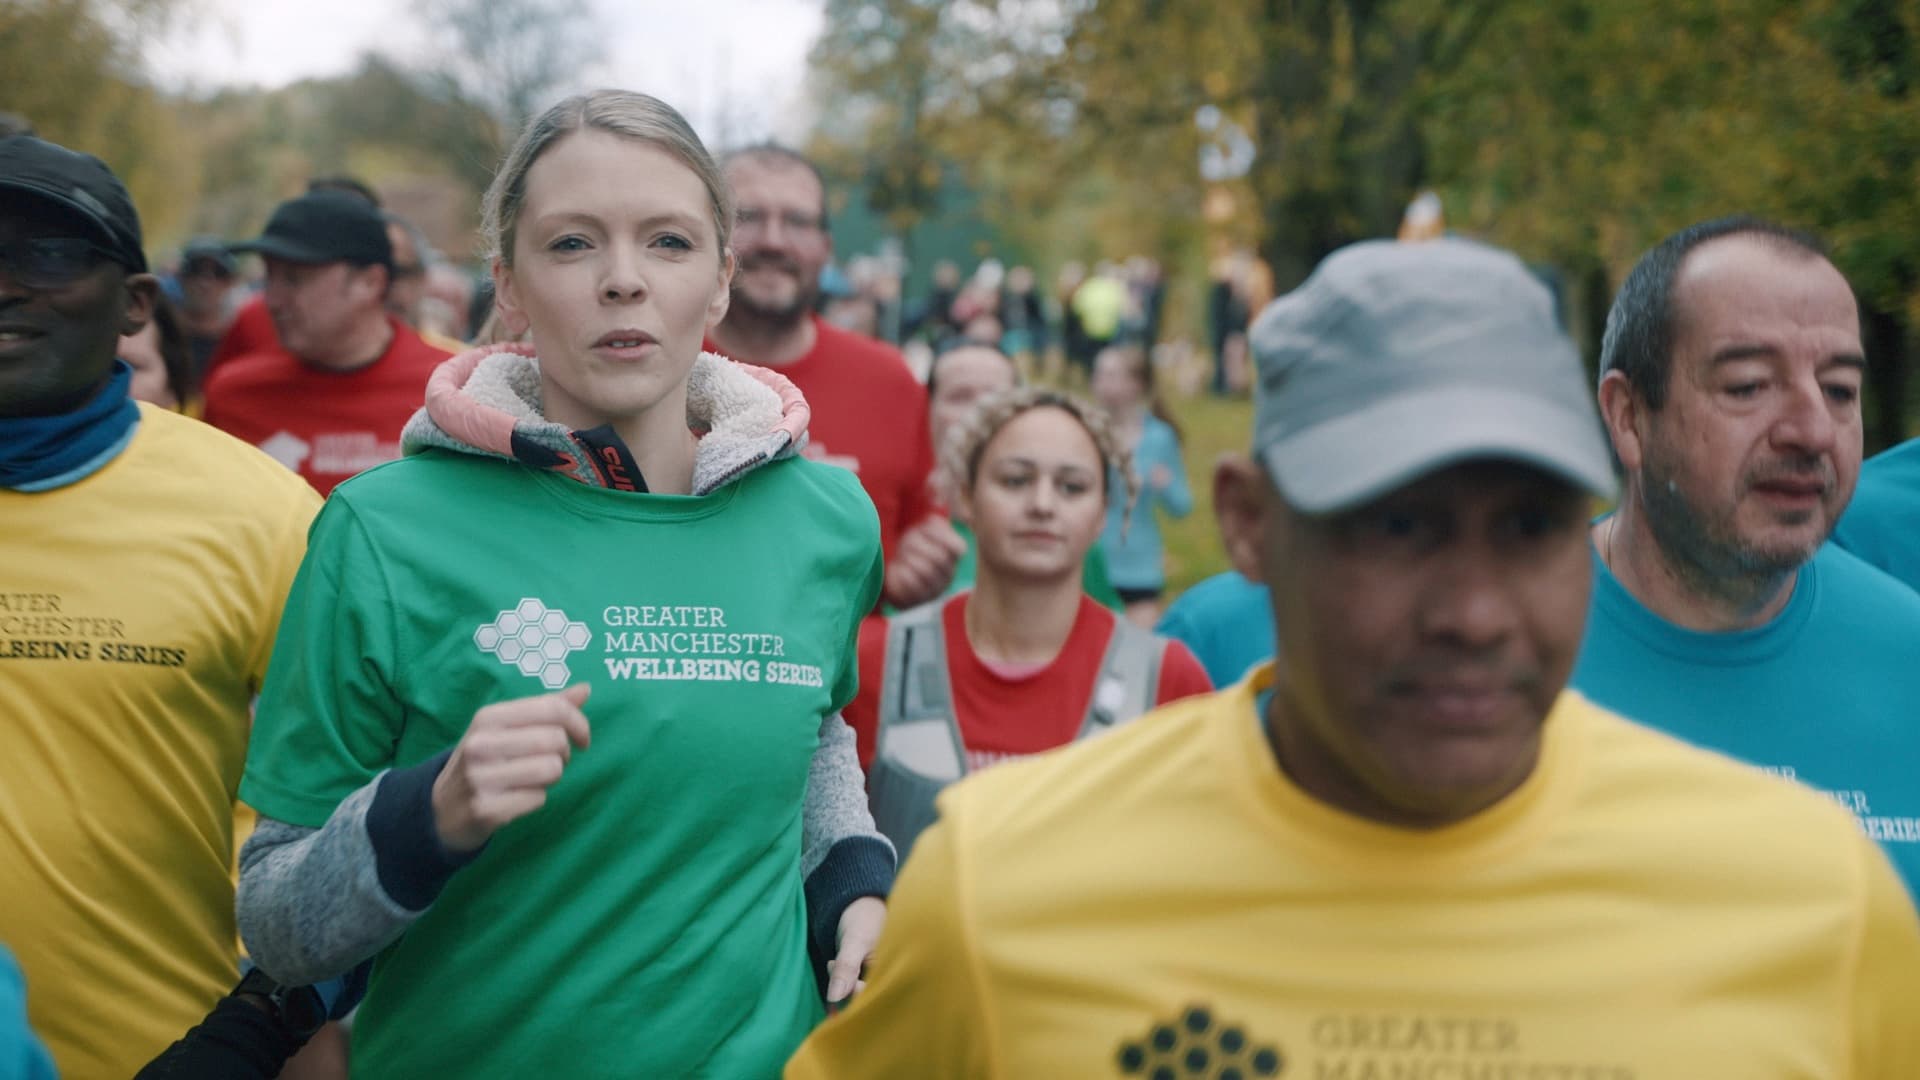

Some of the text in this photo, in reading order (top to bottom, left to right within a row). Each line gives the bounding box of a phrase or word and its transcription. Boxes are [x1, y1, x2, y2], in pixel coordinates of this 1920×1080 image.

[0, 616, 125, 638] CHESTER
[603, 606, 727, 628] GREATER
[98, 641, 187, 667] SERIES
[604, 632, 785, 656] MANCHESTER
[604, 657, 823, 688] WELLBEING SERIES
[1309, 1015, 1521, 1053] GREATER
